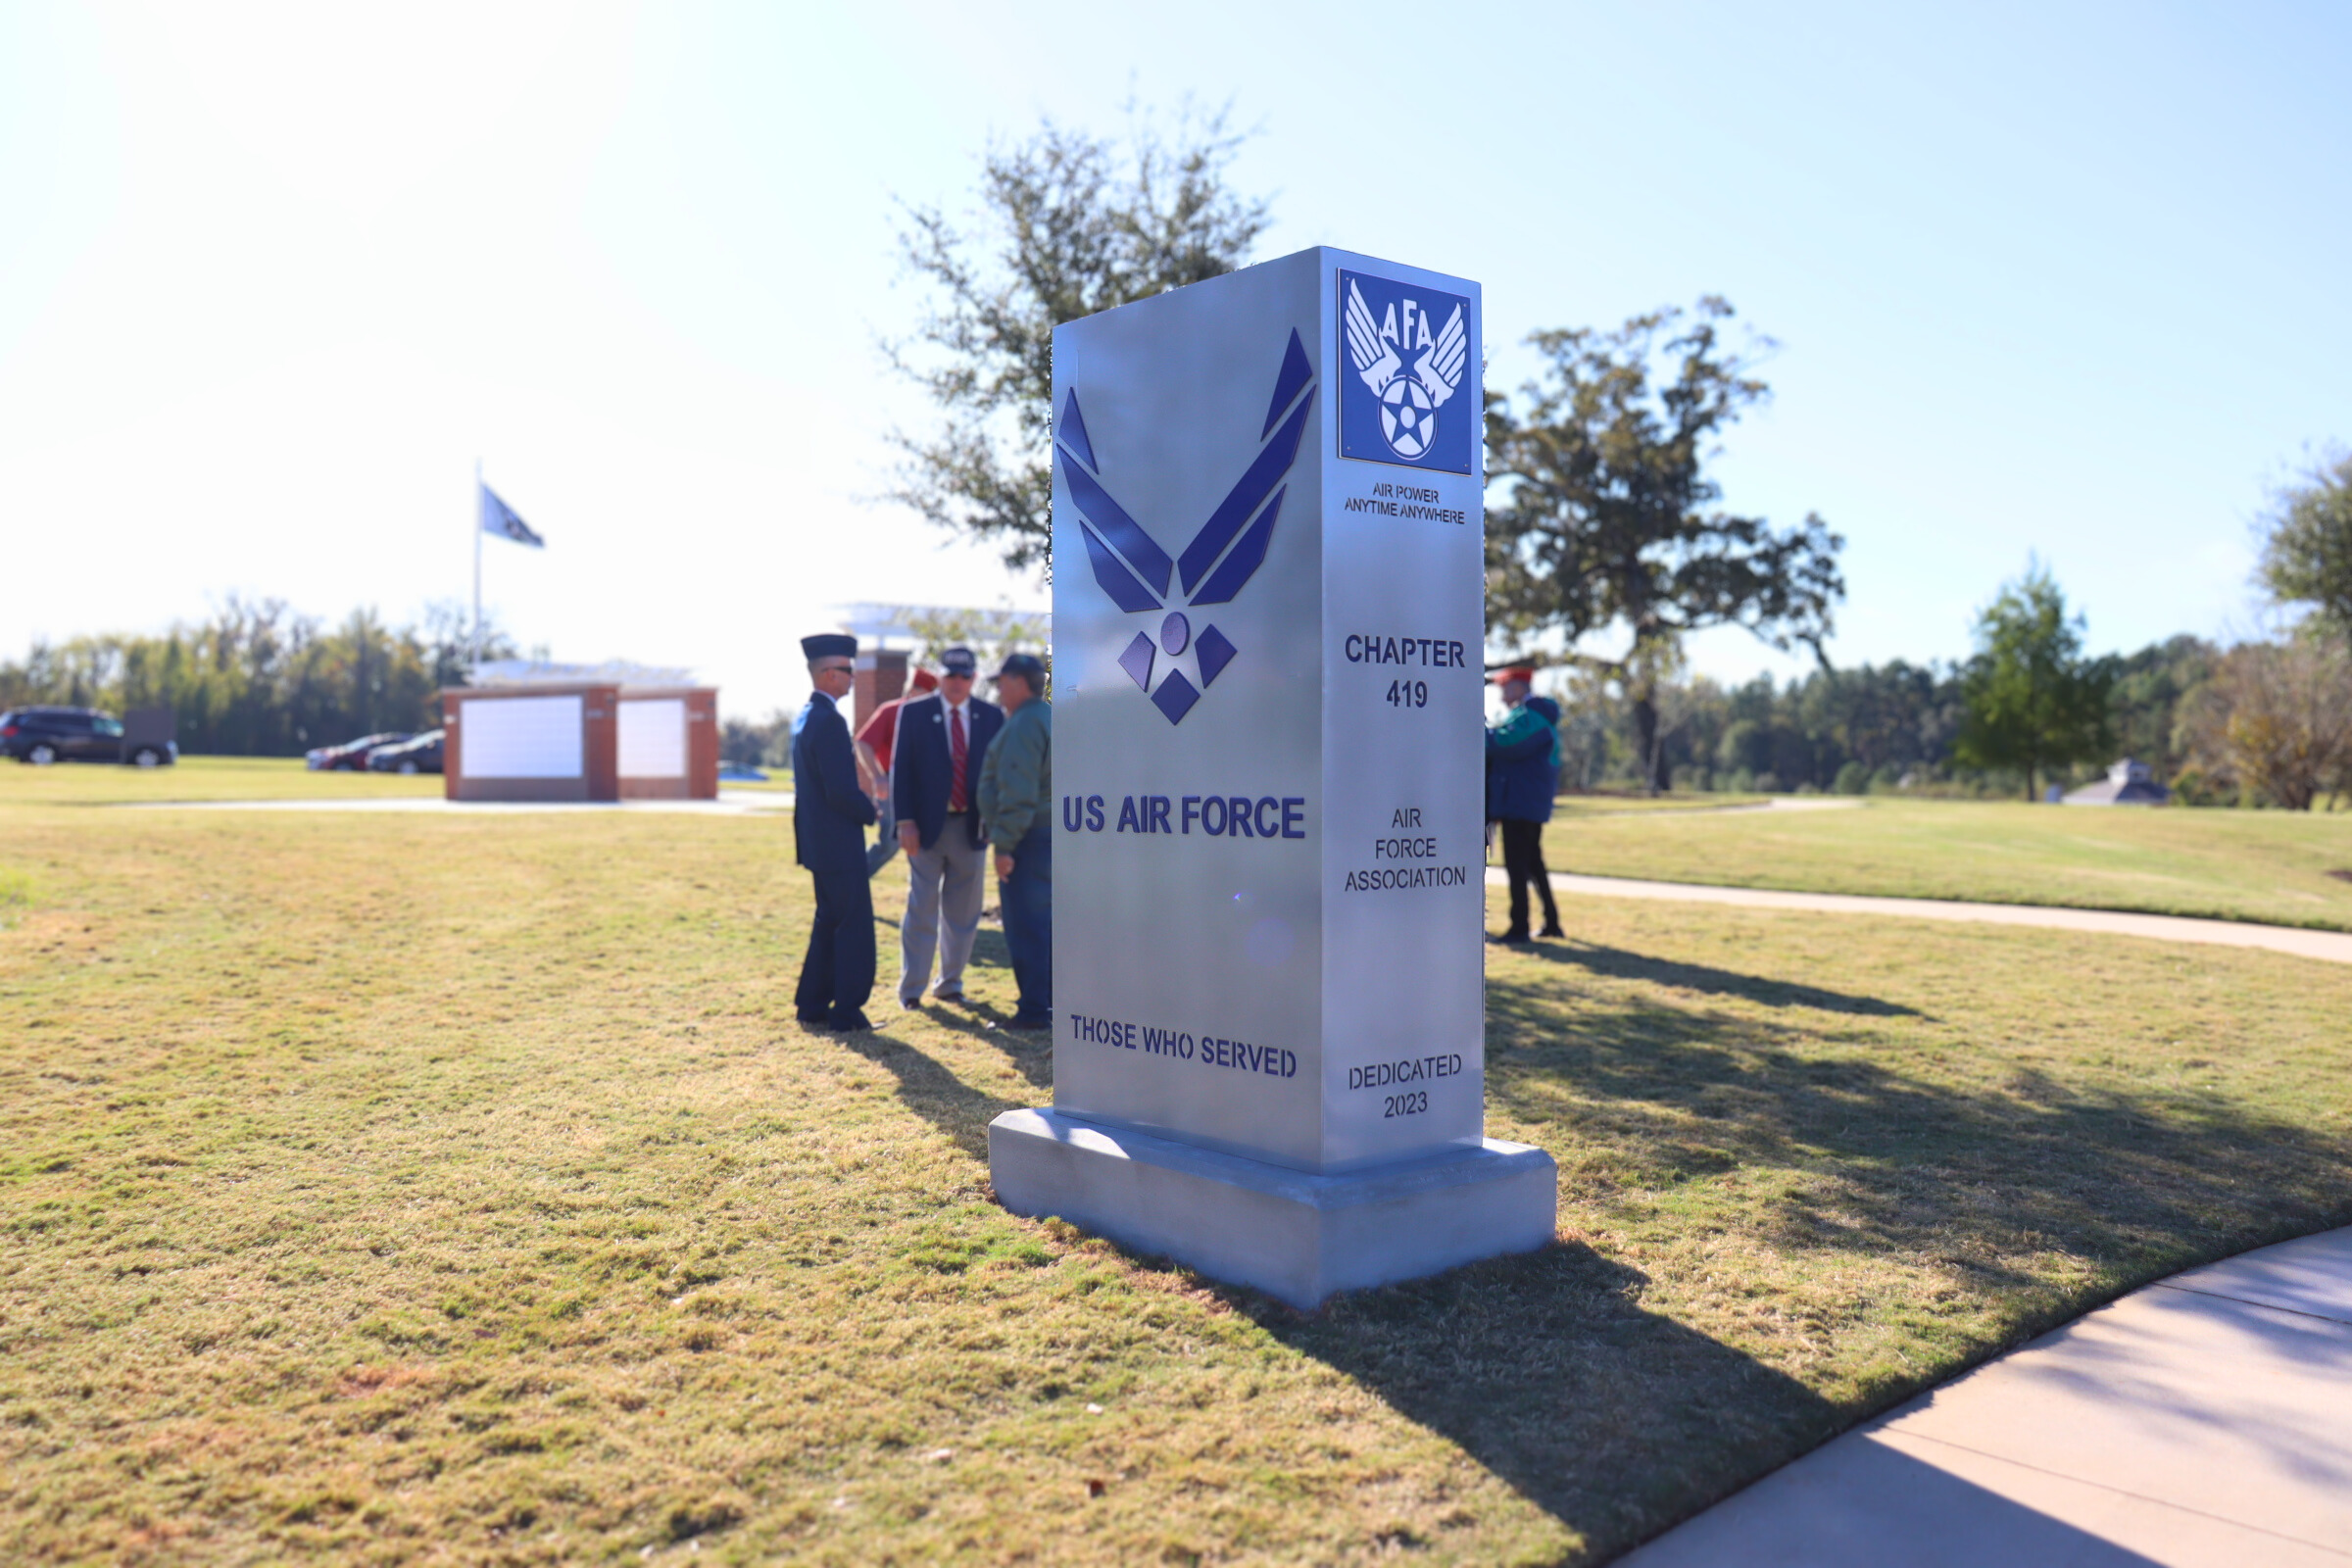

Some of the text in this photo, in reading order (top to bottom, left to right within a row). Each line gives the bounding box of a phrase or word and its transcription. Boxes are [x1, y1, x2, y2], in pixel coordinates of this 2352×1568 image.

[1382, 298, 1432, 350] AFA
[1373, 482, 1440, 504] AIR POWER
[1345, 497, 1465, 524] ANYTIME ANYWHERE
[1345, 634, 1465, 667] CHAPTER
[1386, 680, 1428, 708] 419
[1063, 794, 1305, 839] US AIR FORCE
[1392, 808, 1421, 828] AIR
[1375, 838, 1437, 858] FORCE
[1345, 866, 1465, 891] ASSOCIATION
[1070, 1013, 1297, 1078] THOSE WHO SERVED
[1348, 1054, 1461, 1090] DEDICATED
[1384, 1091, 1428, 1118] 2023
